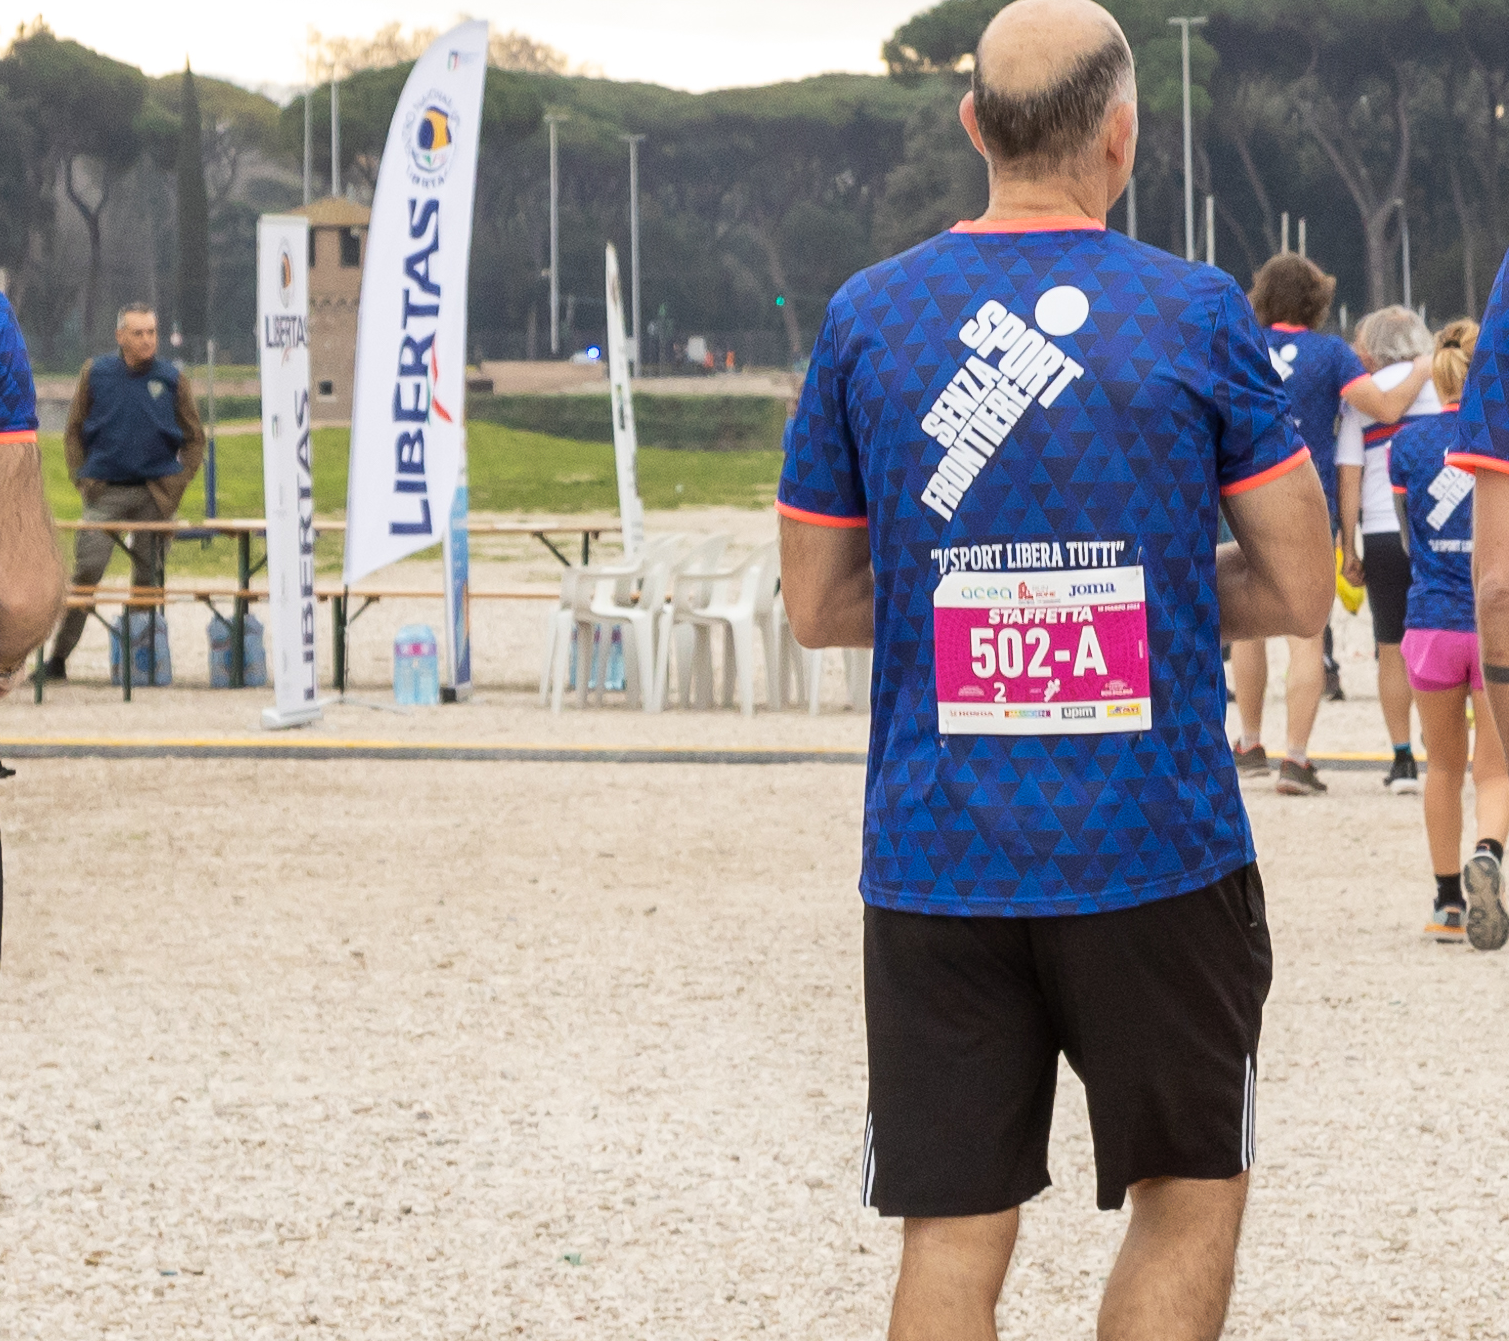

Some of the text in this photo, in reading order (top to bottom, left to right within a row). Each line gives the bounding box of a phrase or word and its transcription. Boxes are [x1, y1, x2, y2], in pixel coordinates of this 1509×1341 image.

[389, 196, 442, 537] LIBERTAS
[959, 300, 1084, 409] SPORT
[921, 355, 1004, 448] SENZA
[921, 375, 1033, 522] FRONTIERE
[950, 543, 1004, 571] SPORT
[1005, 541, 1064, 568] LIBERA
[961, 586, 1012, 600] acea
[989, 607, 1094, 625] STAFFETTA
[970, 625, 1108, 678] 502-A
[993, 681, 1007, 703] 2
